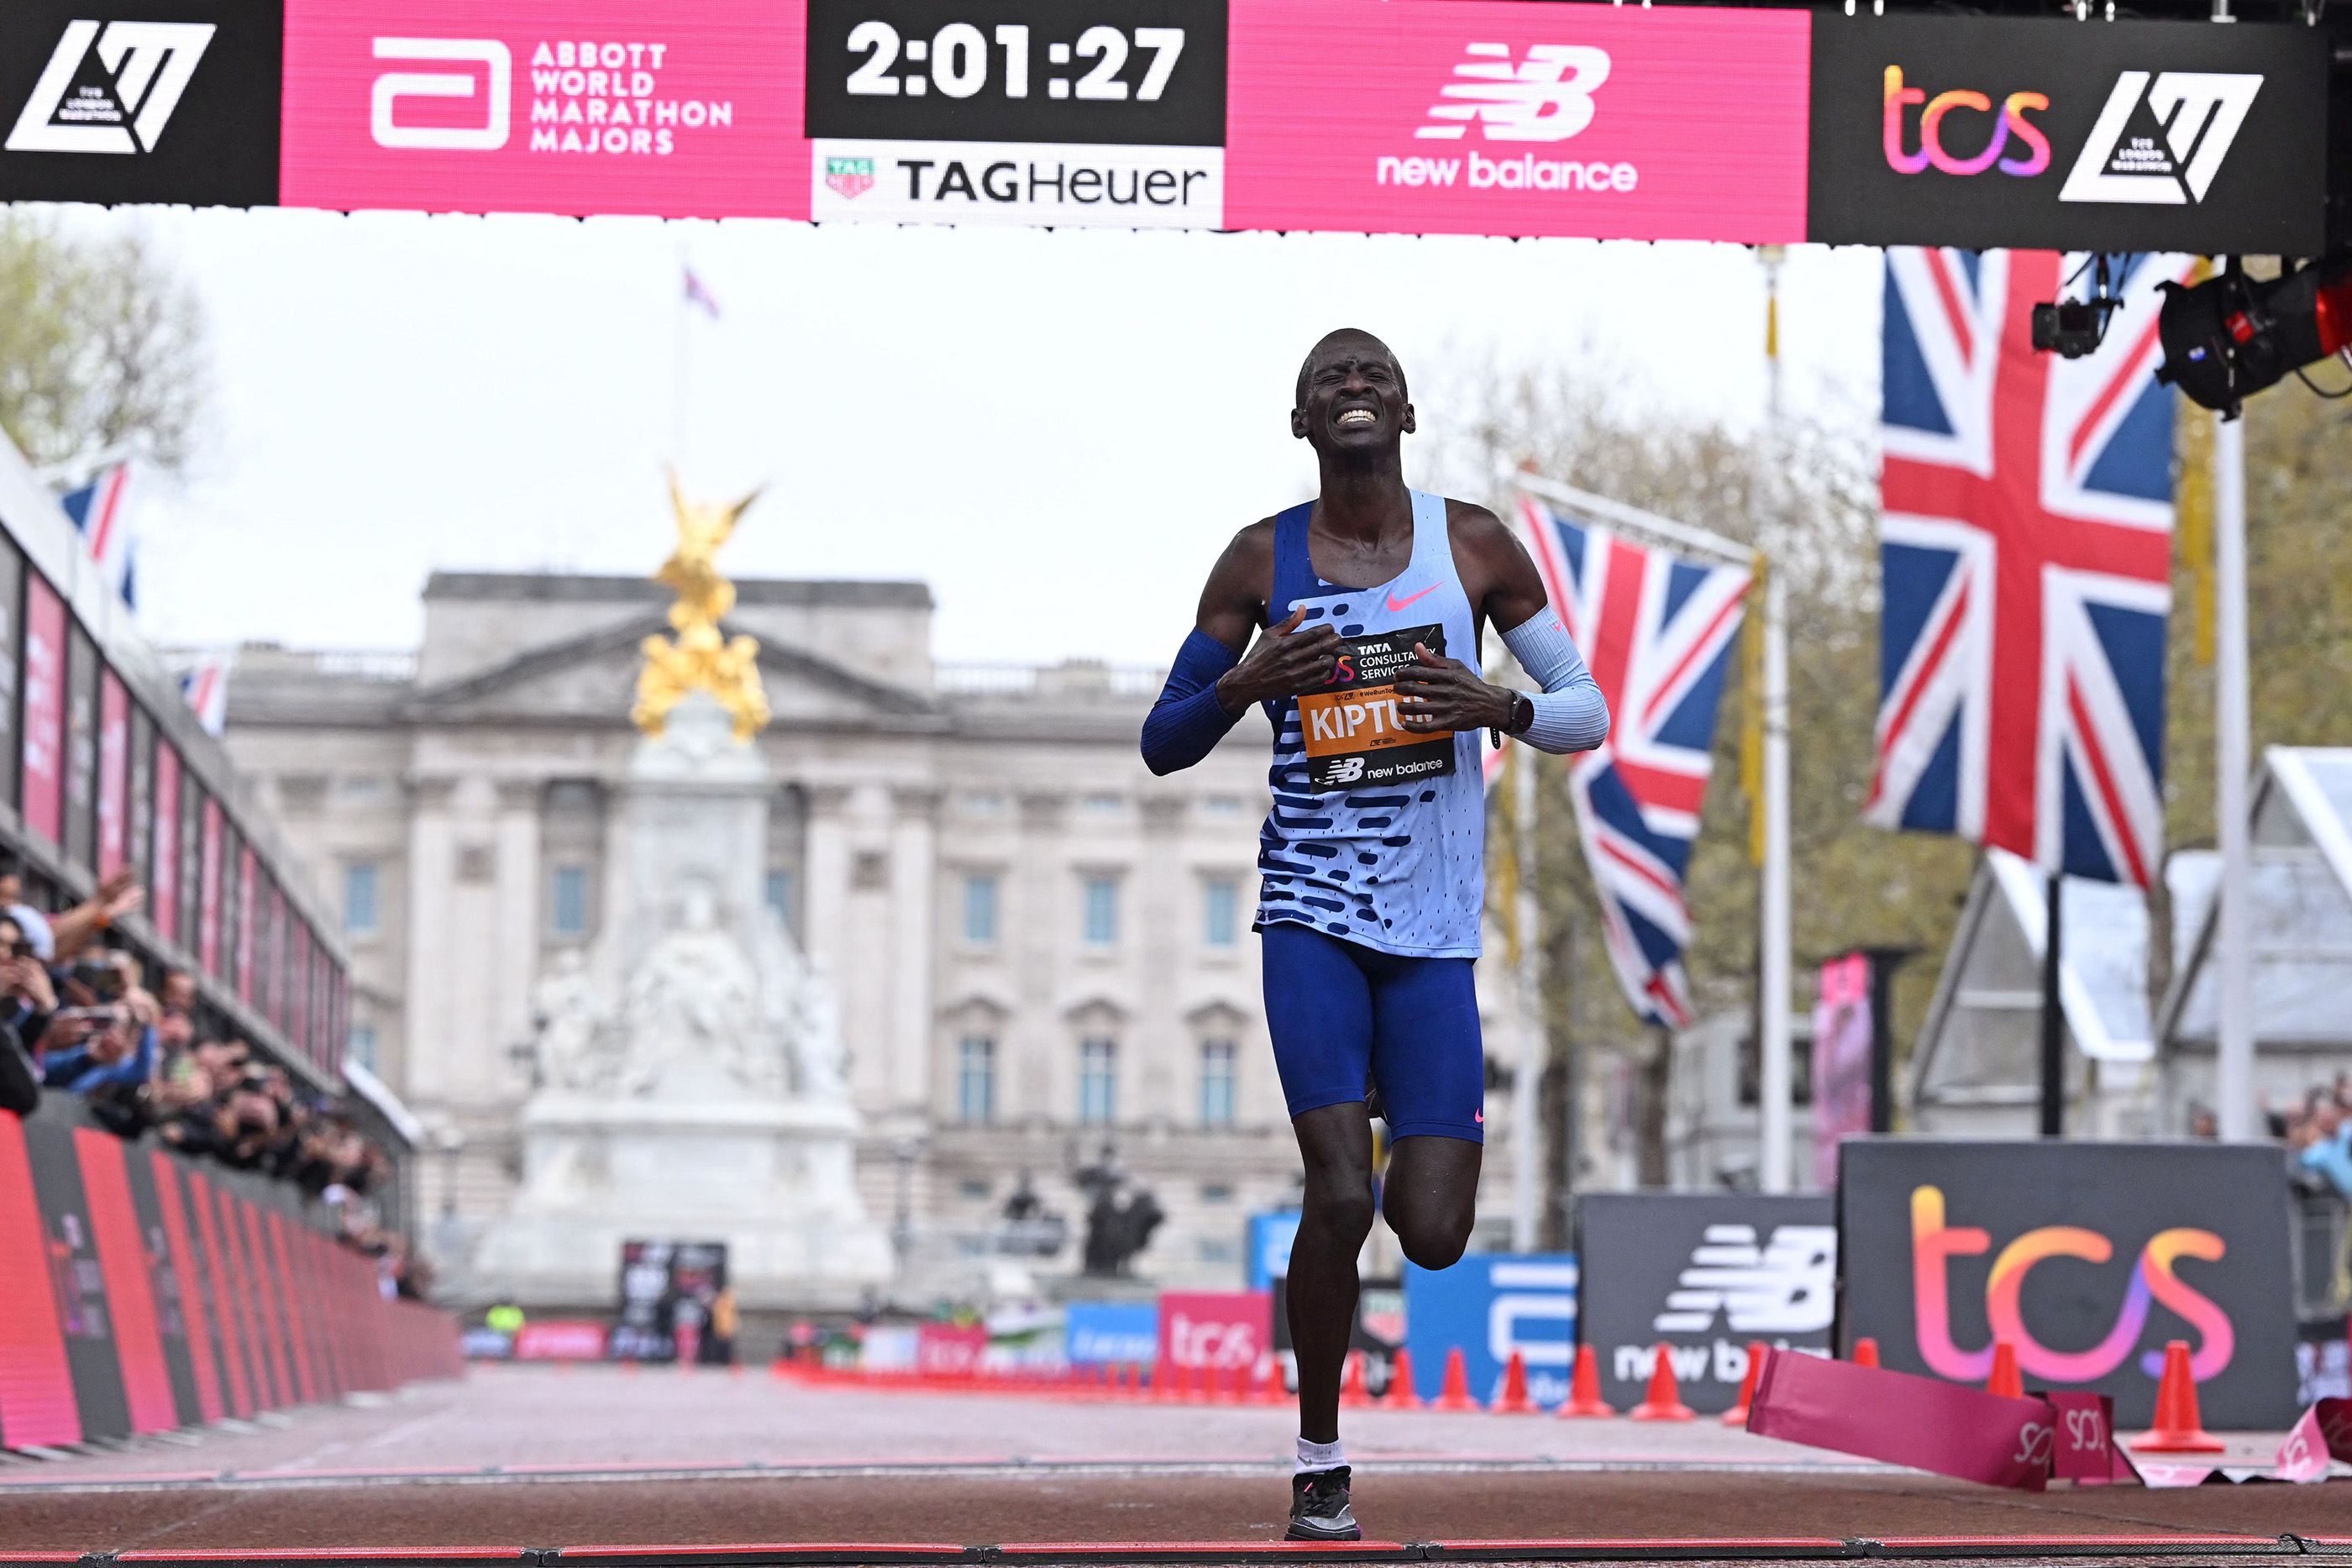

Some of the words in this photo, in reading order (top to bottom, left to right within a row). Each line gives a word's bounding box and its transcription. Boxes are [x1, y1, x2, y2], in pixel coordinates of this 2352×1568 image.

[531, 41, 667, 70] ABBOTT
[846, 20, 1186, 102] 2:01:27
[531, 70, 654, 98] WORLD
[530, 99, 732, 127] MARATHON
[1883, 65, 2051, 177] tcs
[529, 128, 675, 155] MAJORS
[1376, 155, 1462, 186] new
[1467, 151, 1639, 192] balance
[1357, 642, 1392, 655] TATA
[1359, 648, 1436, 668] CONSULTAY
[1361, 663, 1410, 680] SERVIC
[1368, 764, 1394, 779] new
[1395, 759, 1443, 776] balance
[1911, 1185, 2235, 1383] tcs
